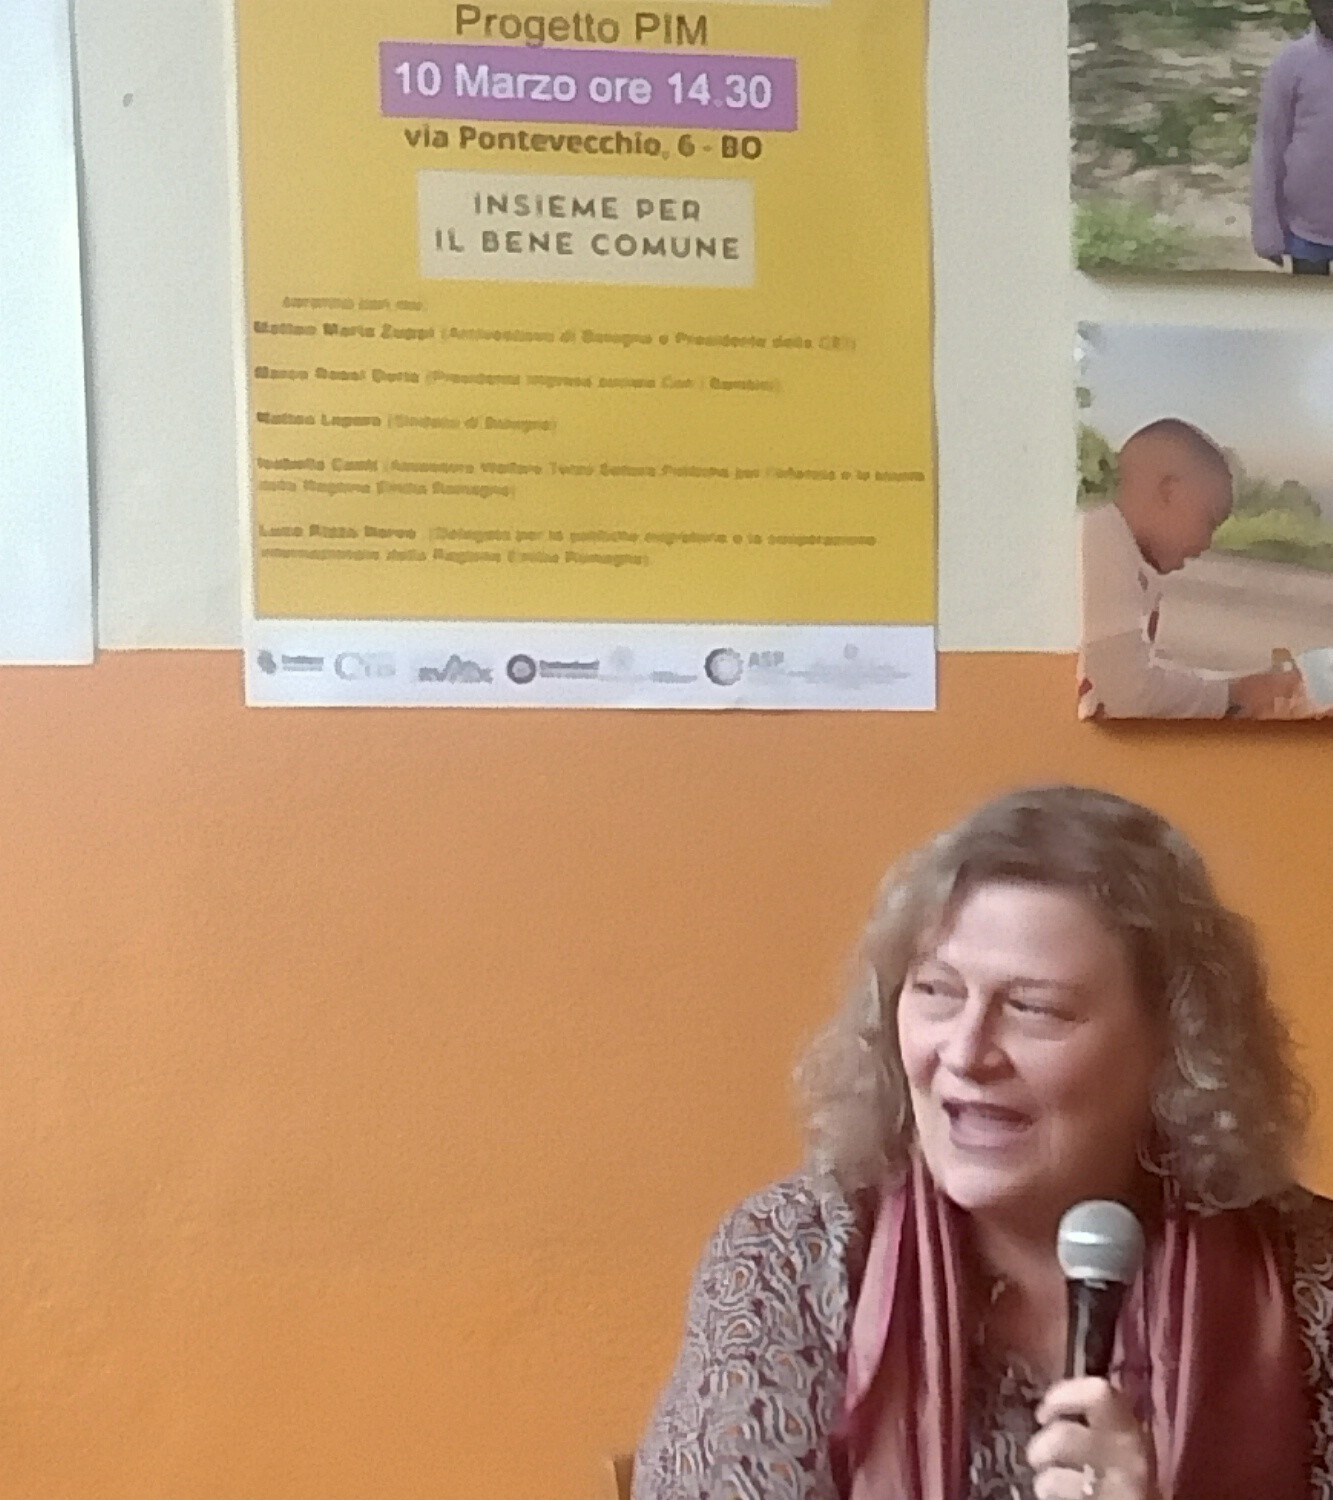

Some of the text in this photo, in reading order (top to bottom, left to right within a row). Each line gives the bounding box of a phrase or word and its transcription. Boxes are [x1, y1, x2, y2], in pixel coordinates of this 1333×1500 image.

[456, 4, 708, 47] Progetto PIM
[395, 61, 772, 109] 10 Marzo ore 14.30
[404, 126, 449, 151] via
[459, 125, 670, 162] Pontevecchio,
[677, 134, 695, 158] 6
[721, 136, 762, 160] BO
[474, 193, 701, 223] INSIEME PER
[434, 227, 740, 261] IL BENE COMUNE
